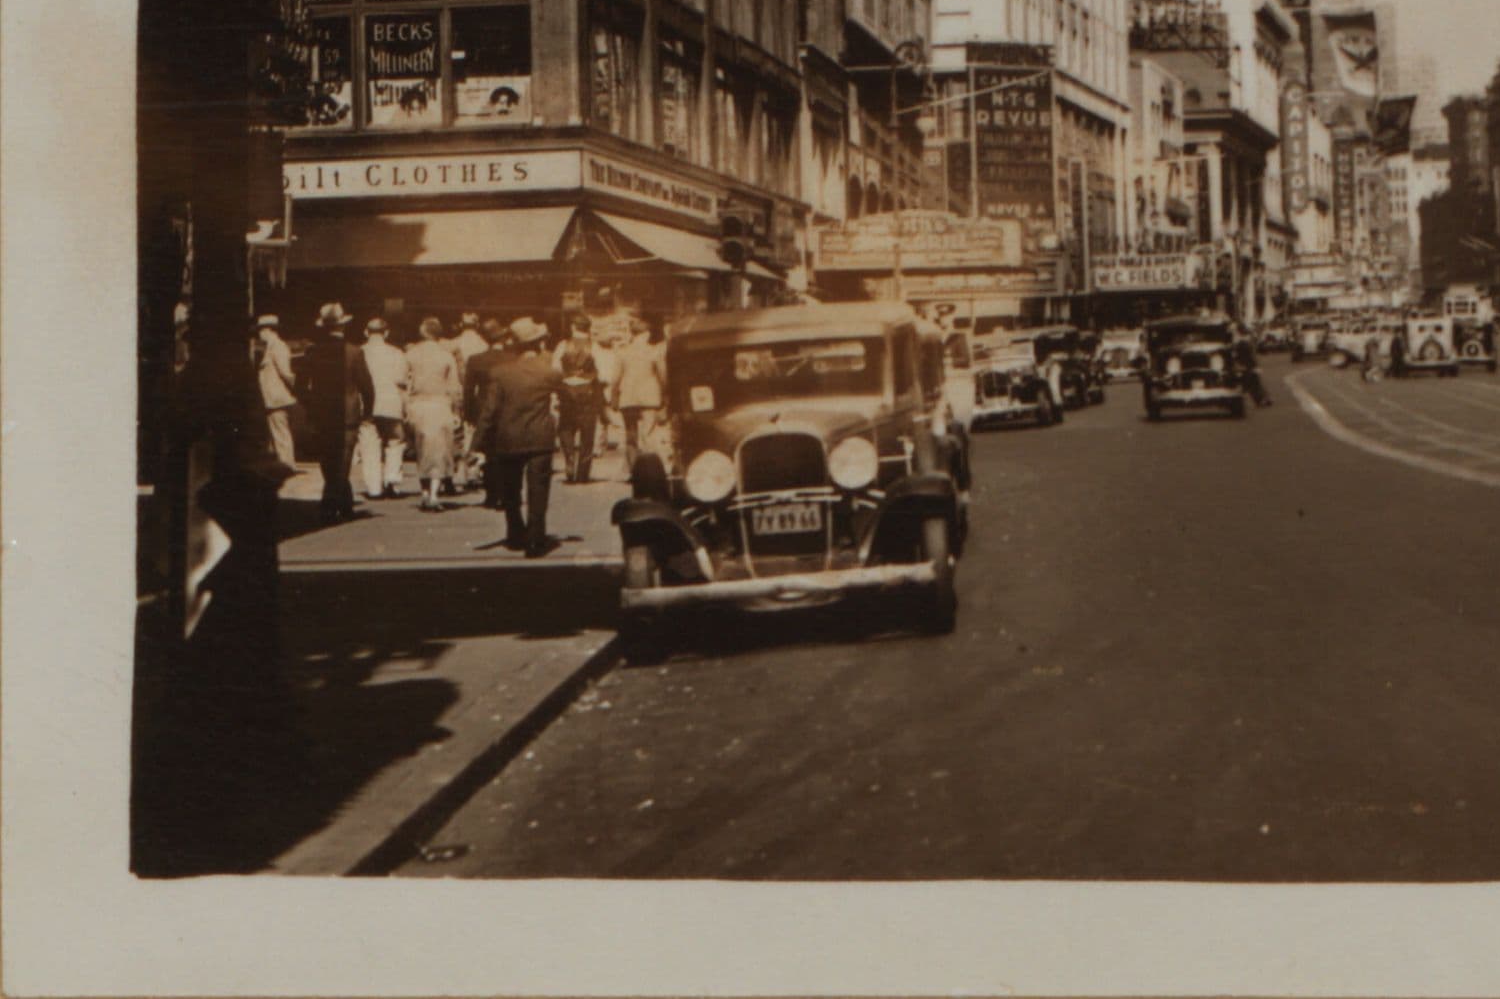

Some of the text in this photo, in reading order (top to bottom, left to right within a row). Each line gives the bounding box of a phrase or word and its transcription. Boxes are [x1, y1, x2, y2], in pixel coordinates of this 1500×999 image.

[373, 22, 434, 43] BECKS
[370, 42, 437, 74] MILLINERY
[976, 110, 1051, 127] REVUE
[1286, 86, 1306, 208] CAPITOL
[365, 161, 529, 188] CLOTHES
